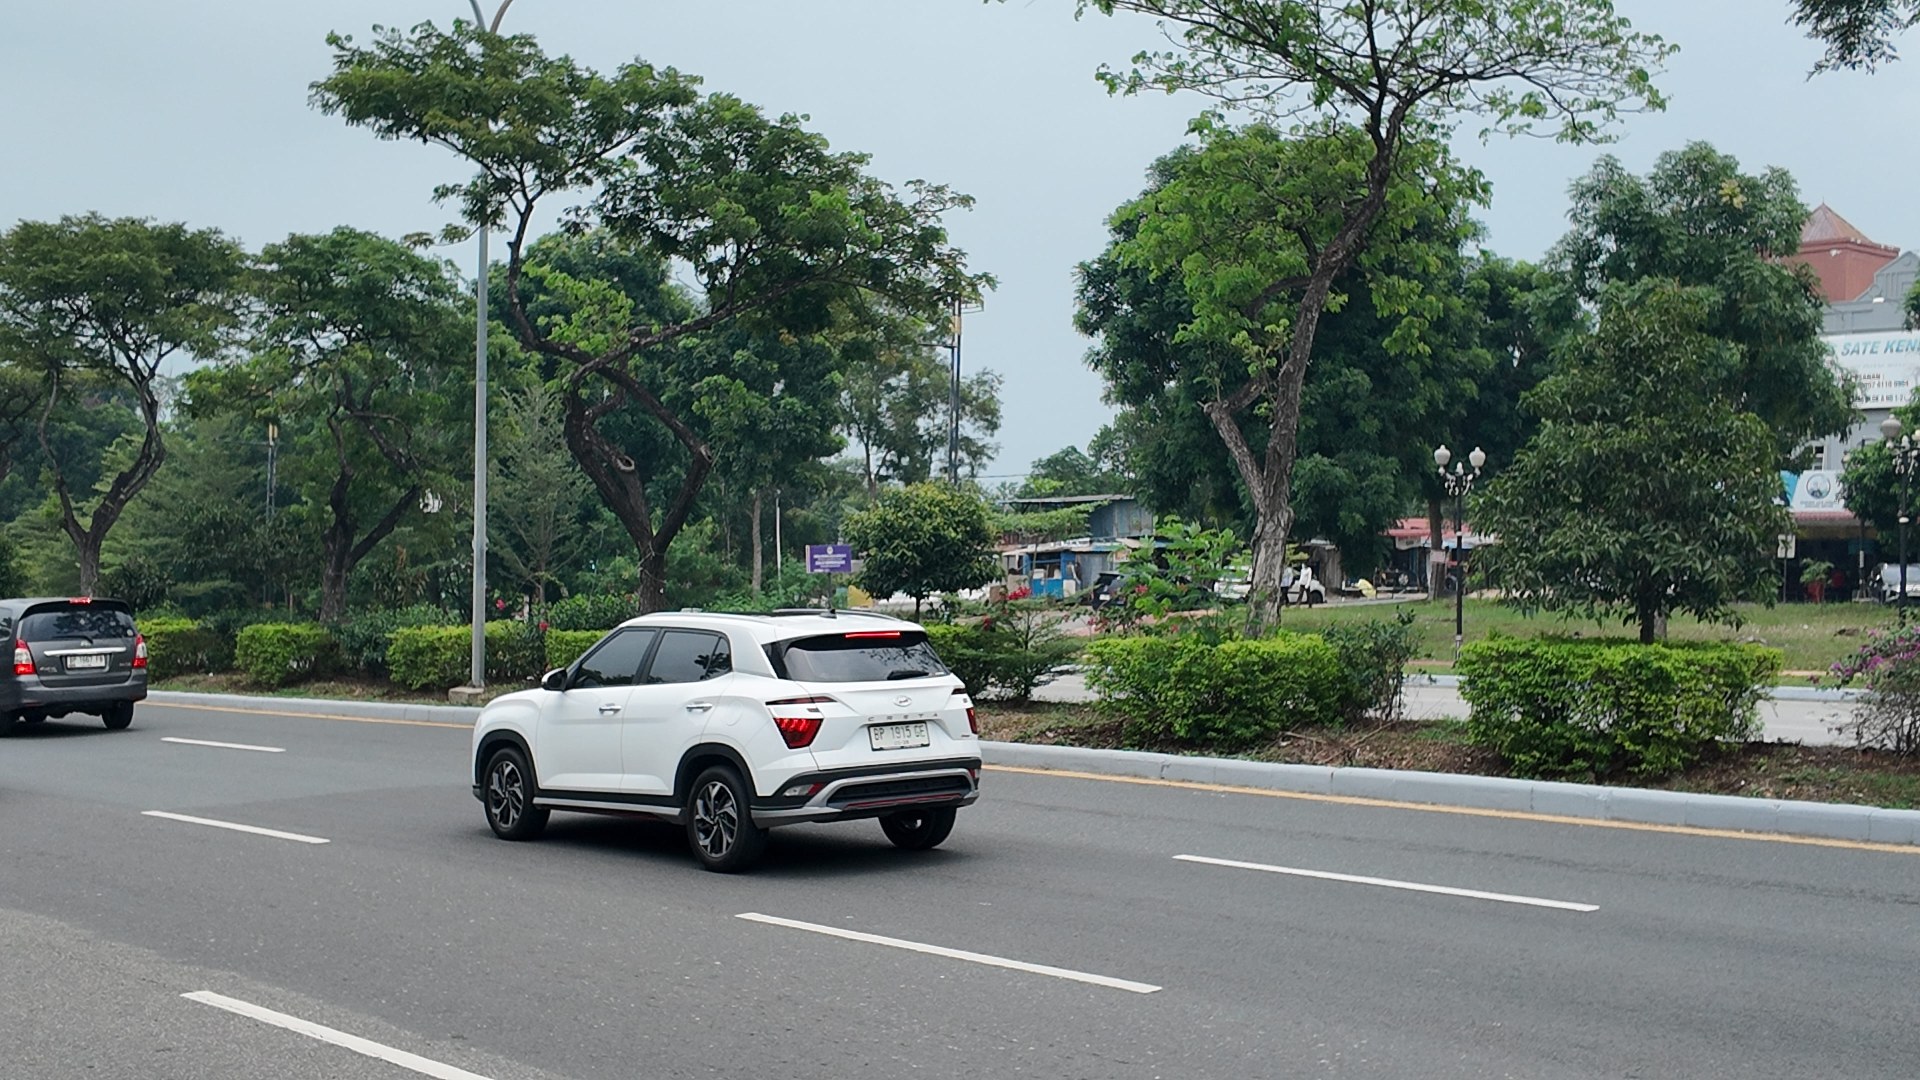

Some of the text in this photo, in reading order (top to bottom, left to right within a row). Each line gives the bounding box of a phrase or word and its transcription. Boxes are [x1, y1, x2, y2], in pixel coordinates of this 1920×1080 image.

[1841, 341, 1880, 356] SATE
[868, 713, 938, 722] CRETA
[873, 727, 885, 741] BP
[890, 725, 912, 739] 1915
